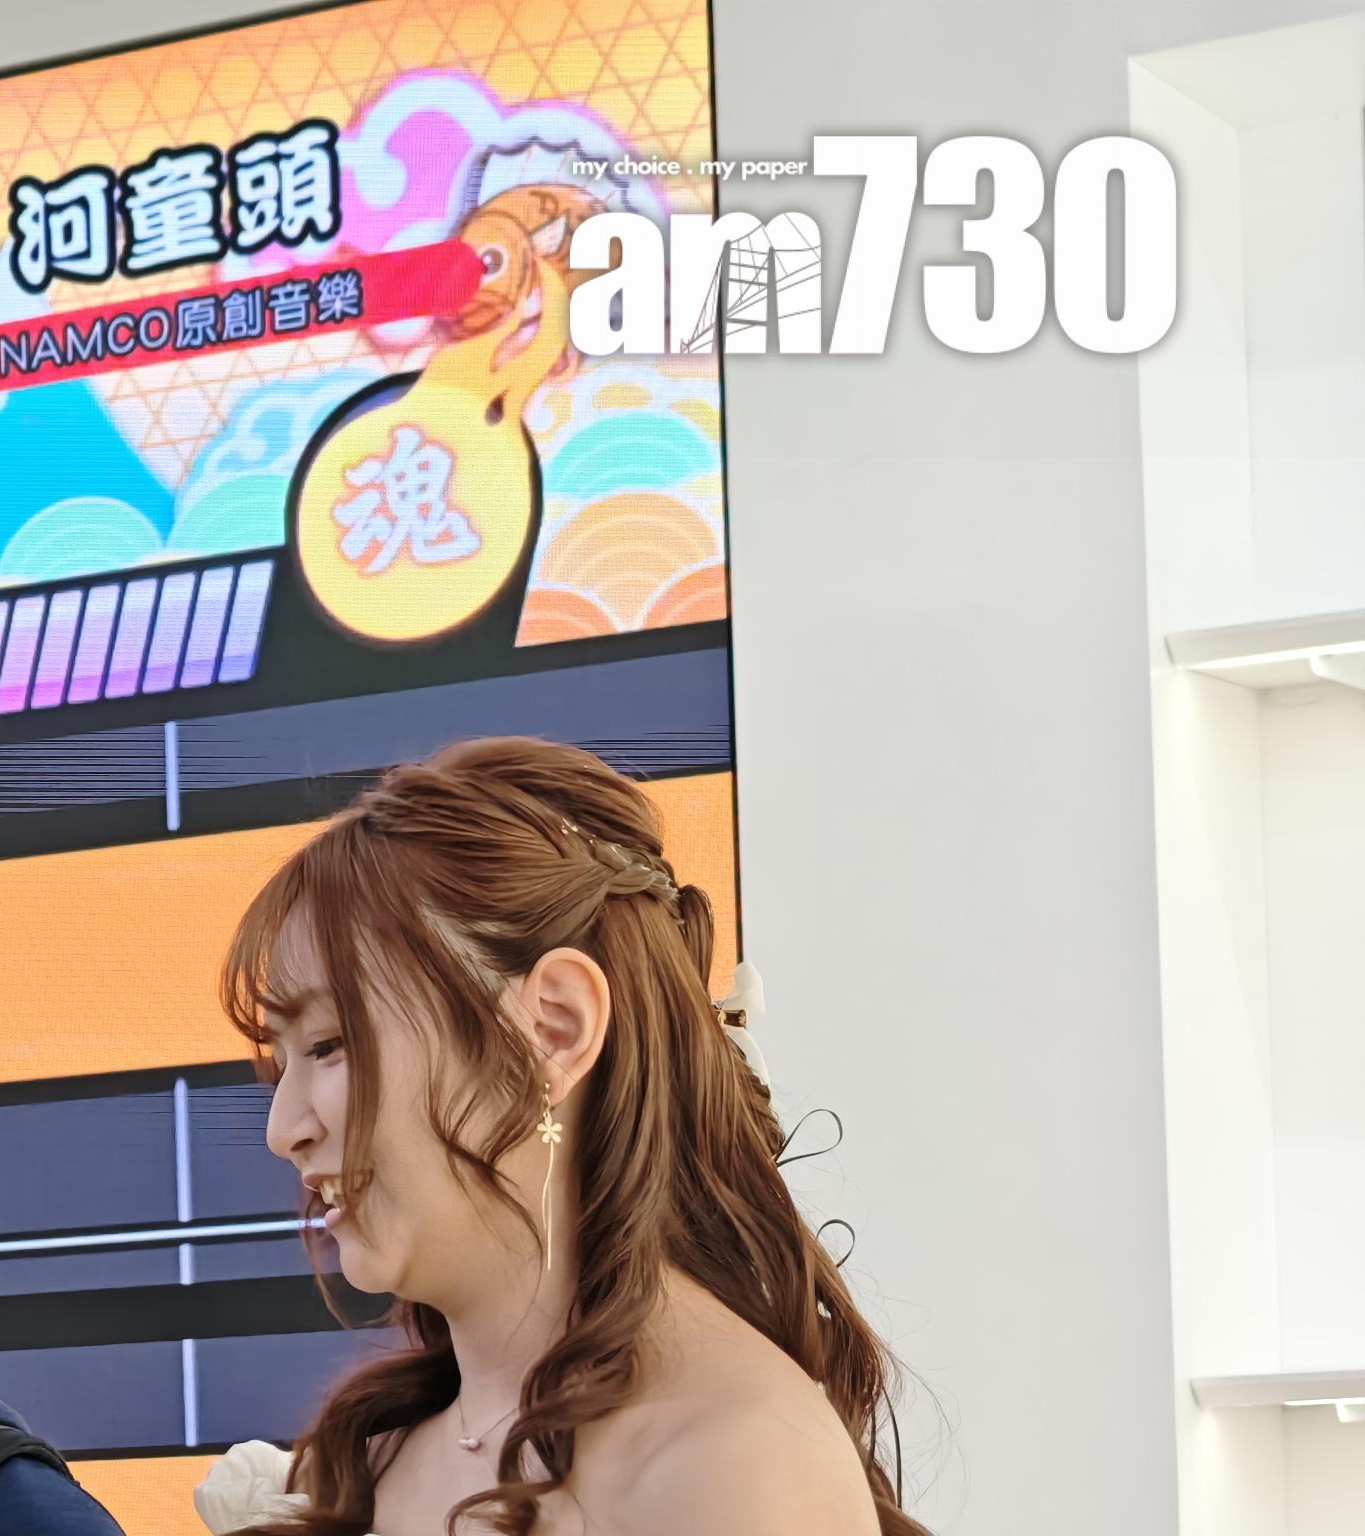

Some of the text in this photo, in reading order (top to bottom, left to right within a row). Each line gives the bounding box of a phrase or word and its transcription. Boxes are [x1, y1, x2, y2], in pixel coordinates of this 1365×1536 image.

[12, 120, 340, 289] 河童頭
[332, 427, 480, 574] 魂
